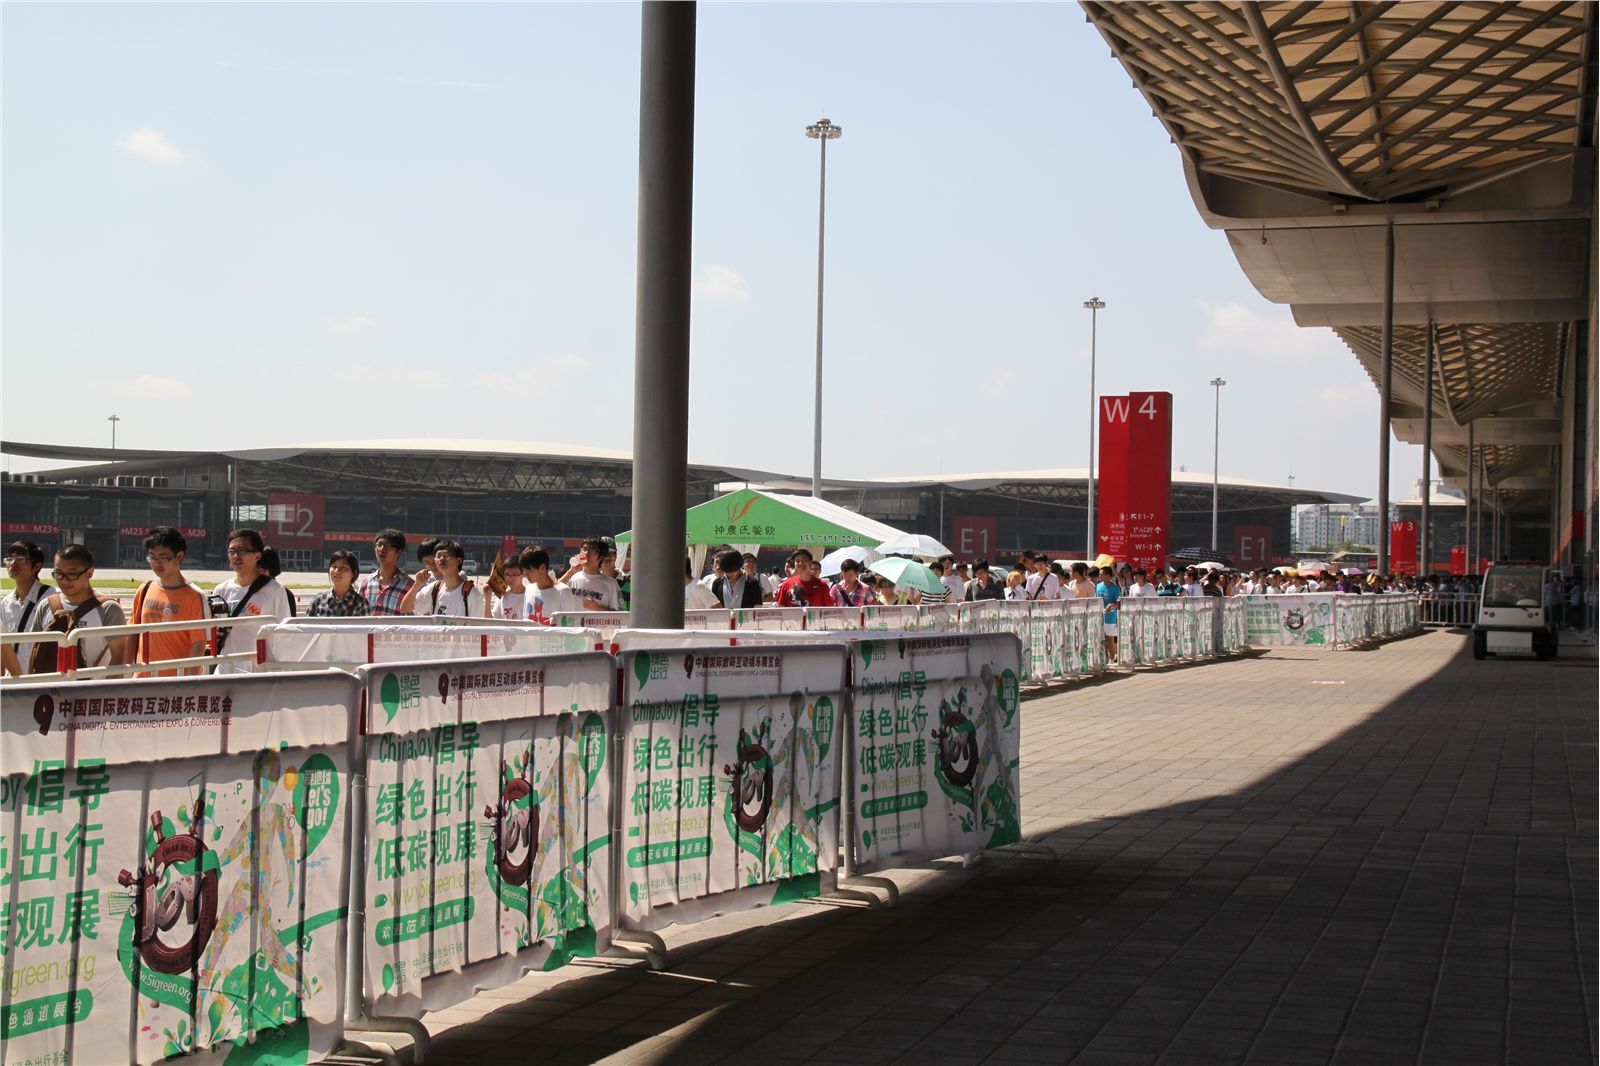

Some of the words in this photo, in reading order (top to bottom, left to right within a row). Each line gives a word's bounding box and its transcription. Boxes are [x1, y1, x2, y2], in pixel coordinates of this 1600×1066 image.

[33, 524, 52, 534] M23
[124, 526, 143, 536] M23
[188, 528, 206, 537] M20
[277, 506, 314, 537] E2
[961, 528, 988, 554] E1
[1240, 536, 1265, 561] E1
[451, 670, 545, 691] 中国国际数码互动娱乐展览会
[58, 694, 233, 718] 中国国际数码互动娱乐展览会
[632, 698, 679, 725] ChinaJoy
[680, 693, 720, 728] 倡导
[859, 704, 929, 738] 绿色出行
[58, 722, 80, 732] CHINA
[81, 721, 107, 731] DIGITAL
[109, 719, 165, 730] ENTERTAINMENT
[166, 718, 183, 728] EXPO
[184, 718, 189, 727] &
[190, 715, 233, 728] CONFERENCE
[379, 731, 433, 765] ChinaJoy
[434, 720, 480, 766] 倡导
[633, 733, 718, 774] 绿色出行
[859, 738, 927, 776] 低碳观展
[24, 757, 111, 817] 倡导
[375, 770, 477, 827] 绿色出行
[631, 775, 718, 816] 低碳观展
[306, 807, 328, 830] go!
[374, 820, 477, 881] 低碳观展
